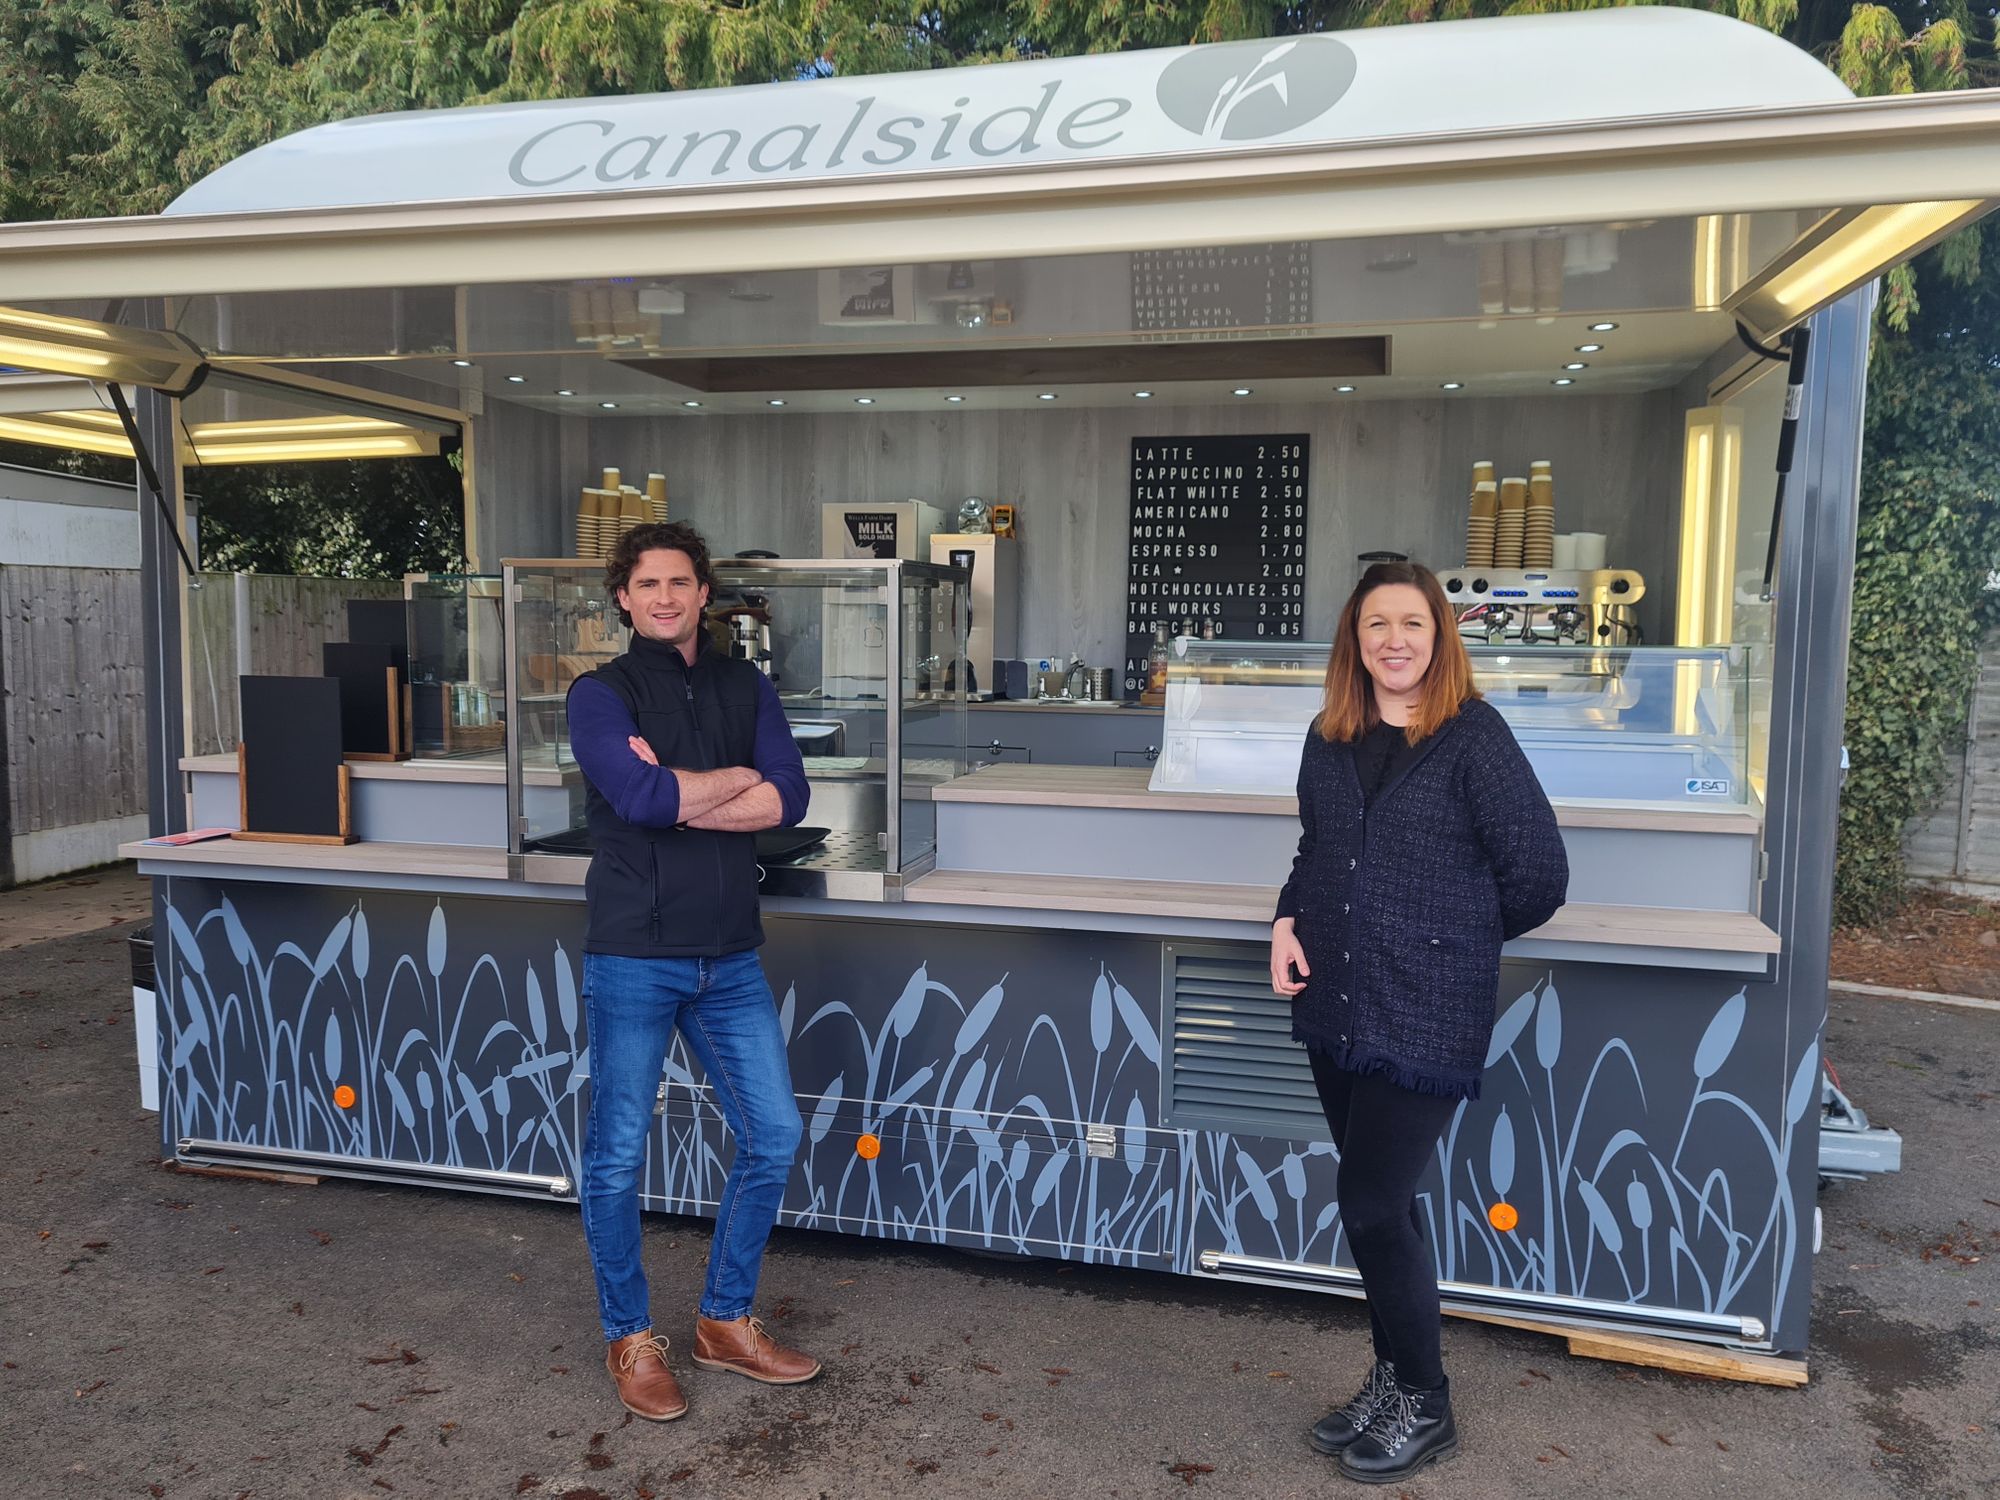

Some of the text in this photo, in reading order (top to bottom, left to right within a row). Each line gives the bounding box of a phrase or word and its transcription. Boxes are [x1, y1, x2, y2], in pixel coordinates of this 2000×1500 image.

[509, 81, 1132, 187] Canalside
[1136, 448, 1192, 460] LATTE
[1136, 467, 1242, 479] CAPPUCCINO
[1138, 487, 1175, 499] FLAT
[1188, 486, 1238, 498] WHITE
[1135, 506, 1228, 518] AMERICANO
[858, 522, 894, 534] MILK
[1134, 526, 1185, 537] MOCHA
[1133, 545, 1217, 557] ESPRESSO
[1133, 564, 1160, 576] TEA
[1130, 583, 1254, 595] HOTCHOCOLATE
[1131, 602, 1157, 614] THE
[1169, 603, 1220, 614] WORKS
[1129, 621, 1223, 634] BABCIO
